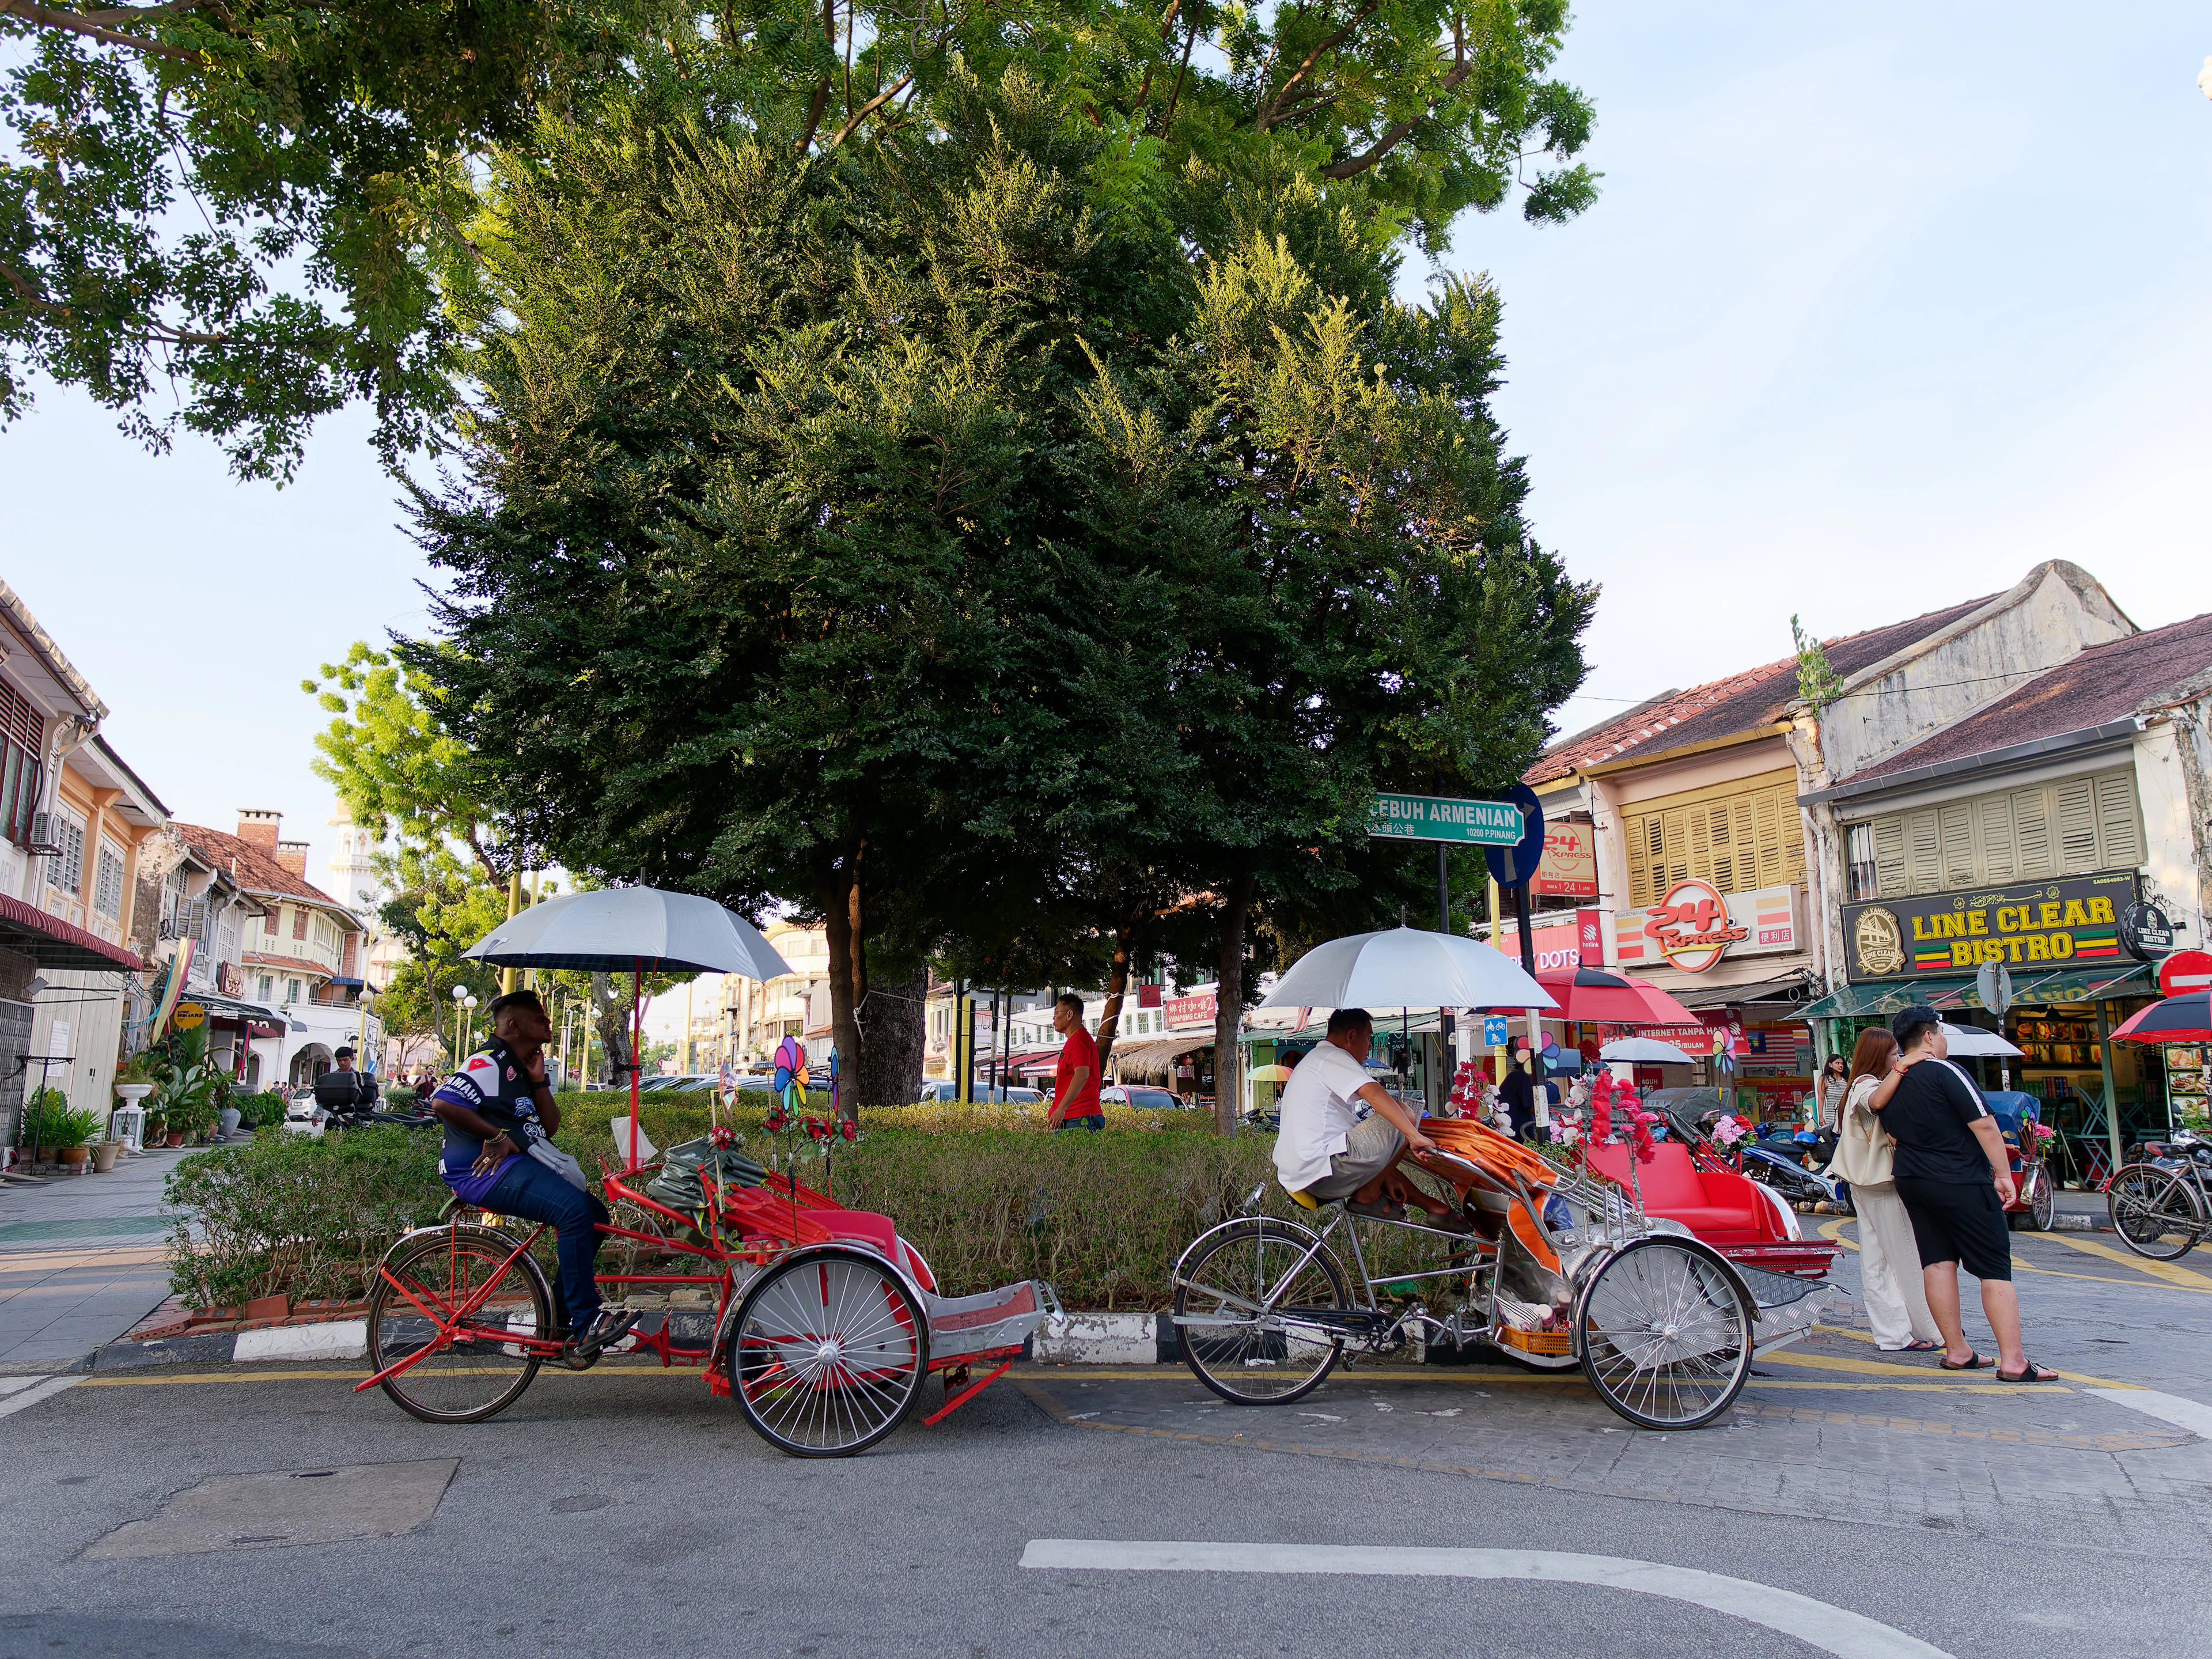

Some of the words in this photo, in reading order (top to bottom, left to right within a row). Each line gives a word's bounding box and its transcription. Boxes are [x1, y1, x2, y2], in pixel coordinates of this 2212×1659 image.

[1370, 800, 1424, 820] LEBUH
[1429, 804, 1516, 828] ARMENIAN
[1466, 828, 1484, 838] 10200
[1485, 830, 1516, 840] P.PINANG
[1543, 835, 1580, 851] 24
[1550, 849, 1592, 859] XPRESS
[1564, 882, 1576, 892] 24
[1644, 899, 1719, 938] 24
[1858, 910, 1869, 923] NASI
[1870, 908, 1892, 919] KANDAR
[1912, 908, 1990, 941] LINE
[1996, 895, 2116, 933] CLEAR
[1661, 927, 1748, 948] XPRESS
[1760, 930, 1790, 943] 便利店
[2137, 927, 2151, 935] LINE
[2152, 929, 2170, 937] CLEAR
[2143, 935, 2166, 944] BISTRO
[1863, 950, 1877, 960] LINE
[1877, 949, 1895, 957] CLEAR
[1950, 931, 2074, 967] BISTRO
[1540, 948, 1580, 969] DOTS
[1168, 1014, 1193, 1022] KAMPUNG
[1194, 1011, 1207, 1020] CAFE
[1639, 1028, 1675, 1037] INTERNET
[1677, 1027, 1705, 1036] TANPA
[1706, 1025, 1721, 1035] HA
[1666, 1039, 1705, 1049] 25/BULAN
[444, 1076, 482, 1104] AMAHA
